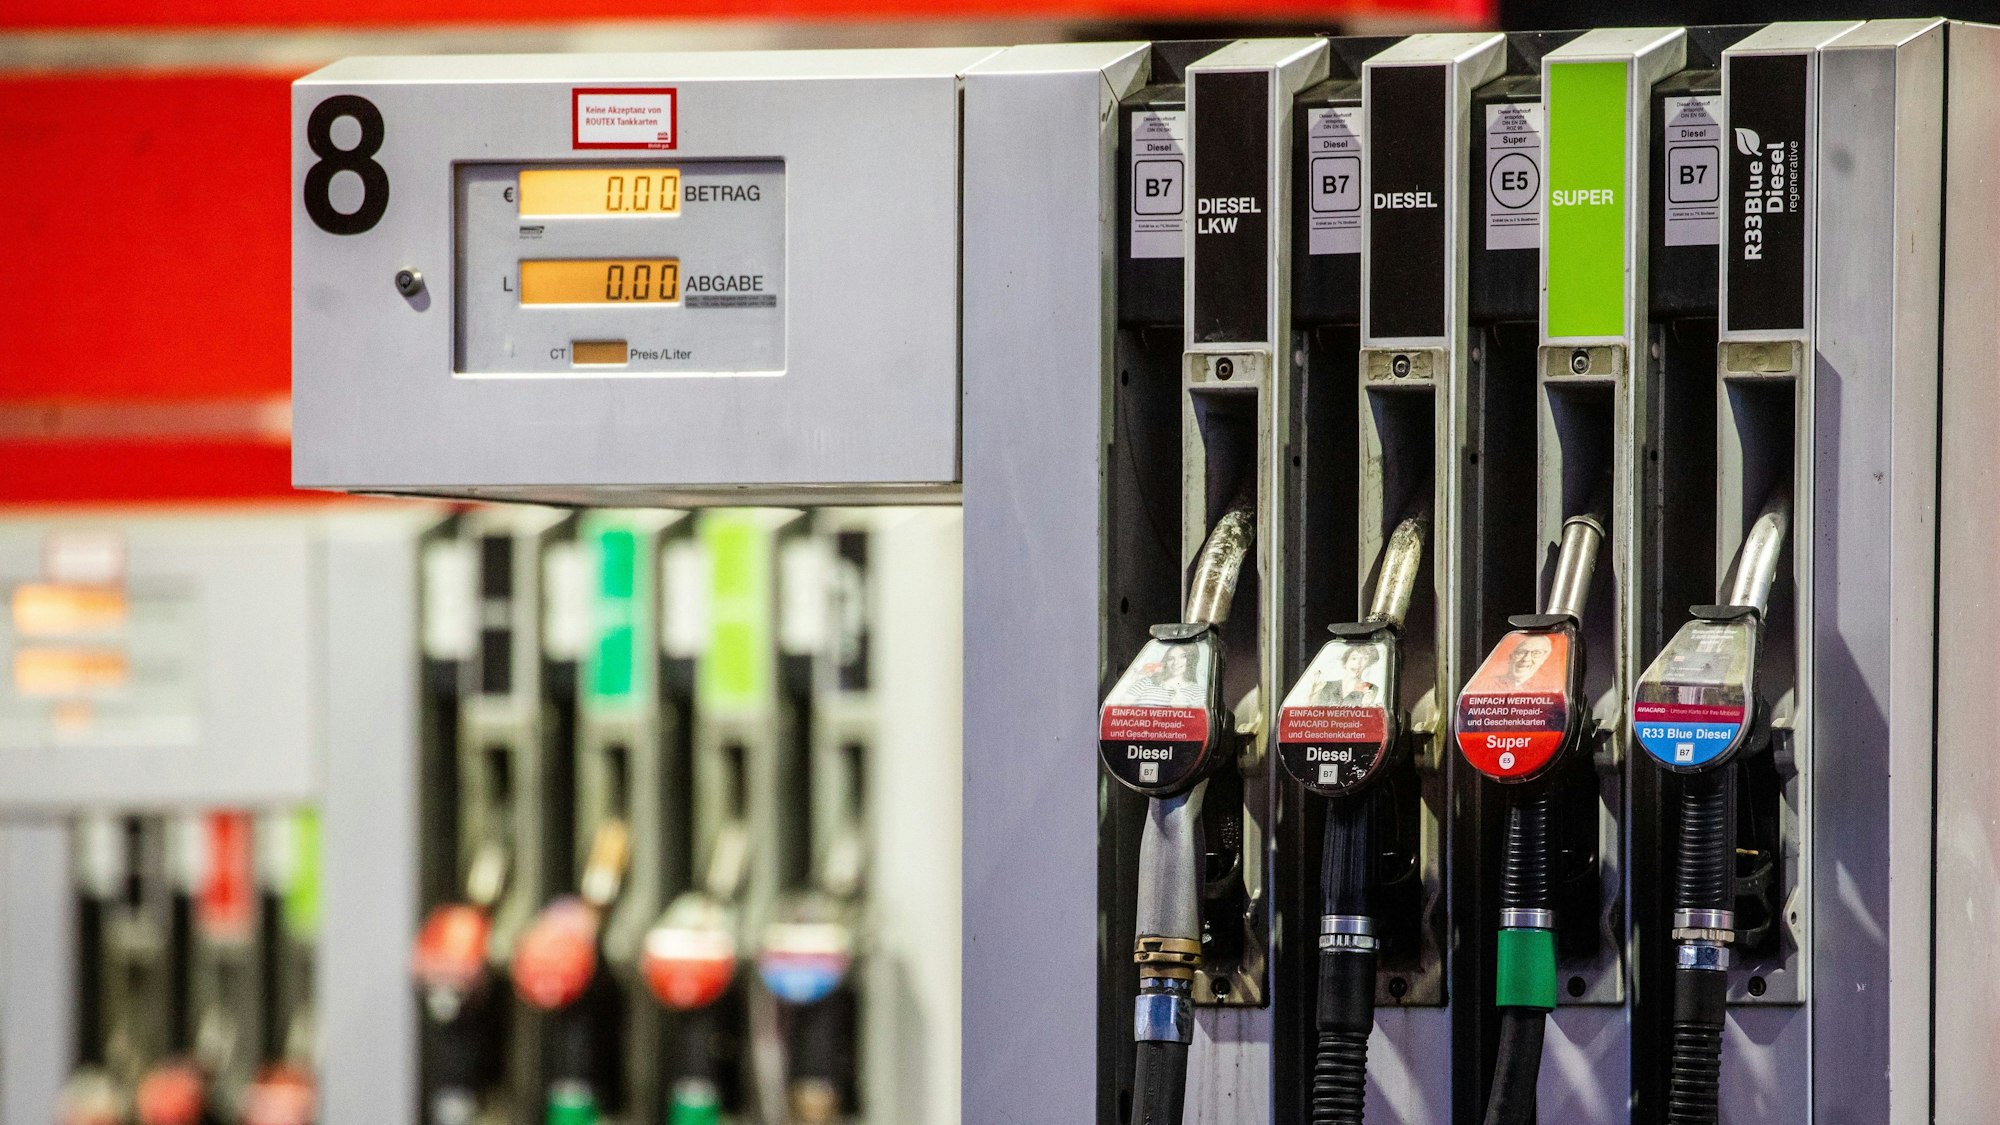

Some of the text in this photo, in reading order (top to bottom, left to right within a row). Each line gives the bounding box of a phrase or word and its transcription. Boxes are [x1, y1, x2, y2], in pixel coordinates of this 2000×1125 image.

[586, 106, 606, 114] Keine
[608, 106, 646, 115] Akzeptanz
[617, 117, 658, 125] Tankkarten
[1681, 129, 1706, 138] Diesel
[1147, 143, 1172, 151] Diesel
[1323, 140, 1348, 148] Diesel
[1502, 136, 1527, 145] Super
[304, 95, 389, 235] 8
[1502, 171, 1528, 190] E5
[1680, 165, 1707, 184] B7
[1765, 141, 1785, 214] Diesel
[1788, 140, 1800, 213] regenerative
[1146, 178, 1172, 197] B7
[1323, 175, 1349, 194] B7
[503, 176, 677, 211] € 0.00
[685, 185, 760, 202] BETRAG
[1374, 191, 1438, 209] DIESEL
[1552, 189, 1614, 207] SUPER
[1198, 196, 1261, 215] DIESEL
[1744, 161, 1763, 260] R33Blue
[1198, 217, 1238, 234] LKW
[503, 265, 677, 300] L 0.00
[685, 275, 763, 292] ABGABE
[550, 348, 566, 360] CT
[1469, 697, 1554, 705] EINFACH WERTVOLL.
[1112, 708, 1195, 718] EINFACH WERTVOLL.
[1289, 709, 1373, 718] EINFACH WERTVOLL.
[1511, 708, 1543, 716] Prepaid-
[1111, 719, 1184, 729] AVIACARD Prepaid-
[1288, 720, 1363, 729] AVIACARD Prepaid-
[1467, 718, 1545, 726] und Geschenkkarten
[1110, 730, 1187, 739] und Geschenkkarten
[1304, 731, 1366, 739] Geschenkkarten
[1642, 728, 1731, 740] R33 Blue Diesel
[1486, 734, 1531, 751] Super
[1127, 745, 1173, 760] Diesel
[1306, 747, 1352, 761] Diesel
[1144, 768, 1154, 776] B7
[1323, 770, 1333, 778] B7
